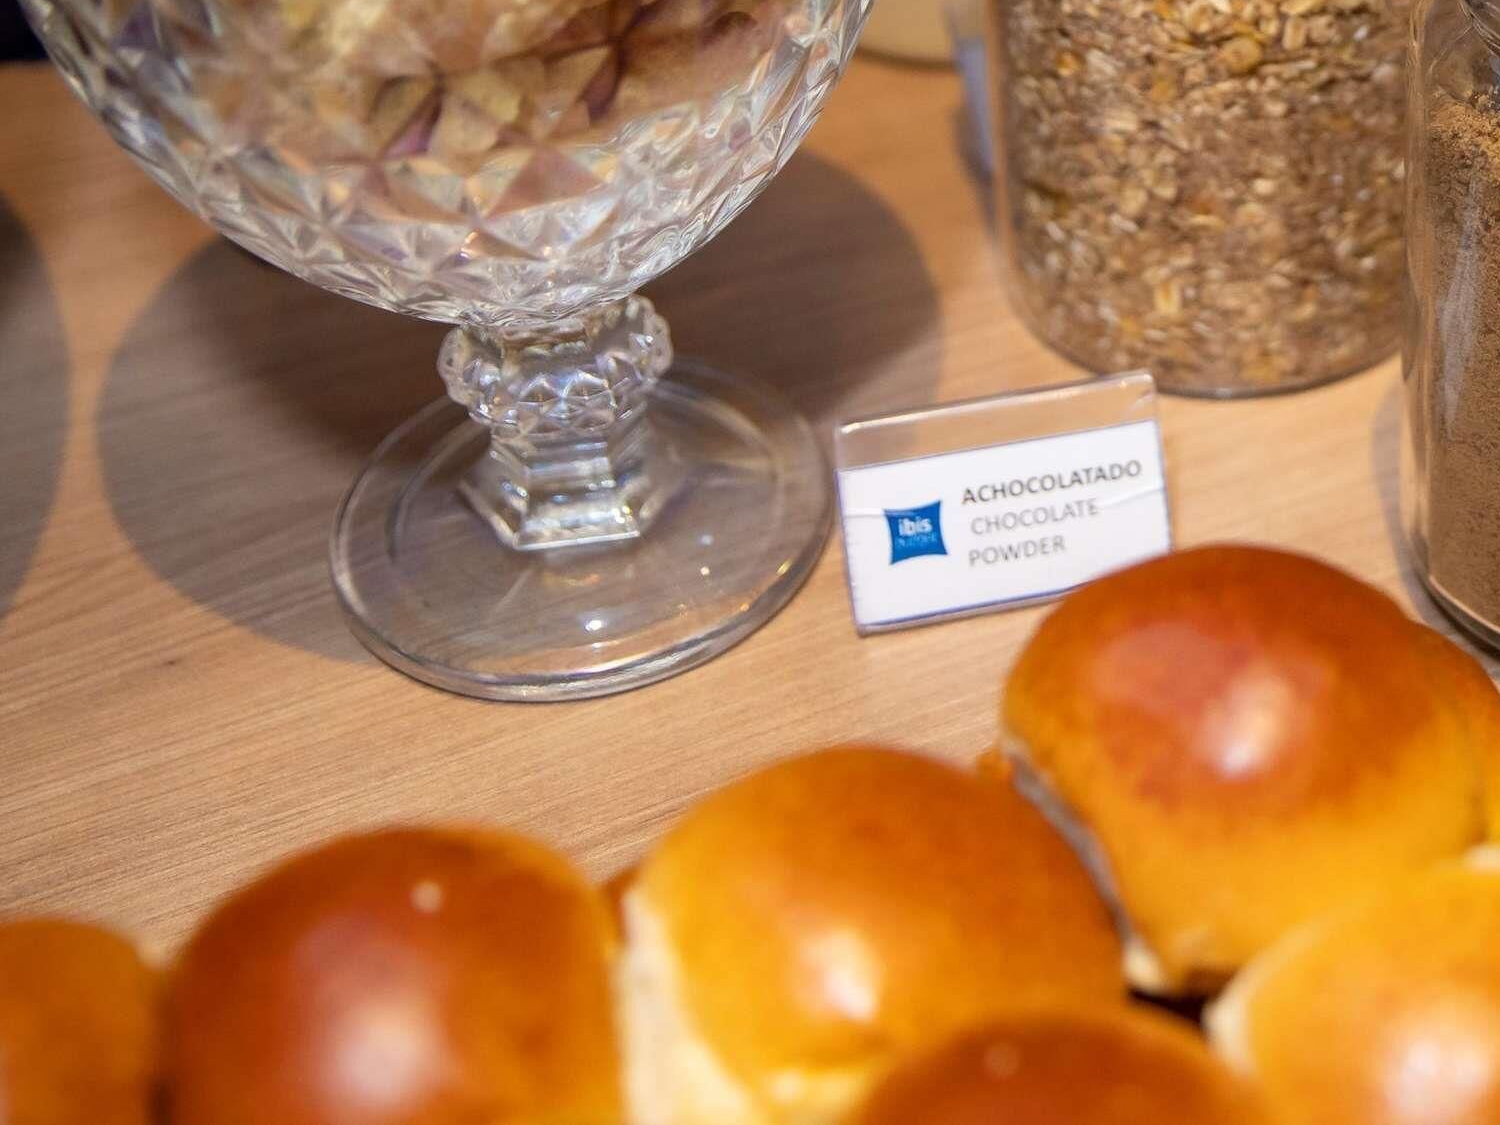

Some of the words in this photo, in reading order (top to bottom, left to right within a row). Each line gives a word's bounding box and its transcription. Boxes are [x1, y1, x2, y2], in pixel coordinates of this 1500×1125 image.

[962, 460, 1142, 505] ACHOCOLATADO
[898, 515, 933, 536] ibis
[970, 498, 1099, 536] CHOCOLATE
[968, 535, 1067, 567] POWDER
